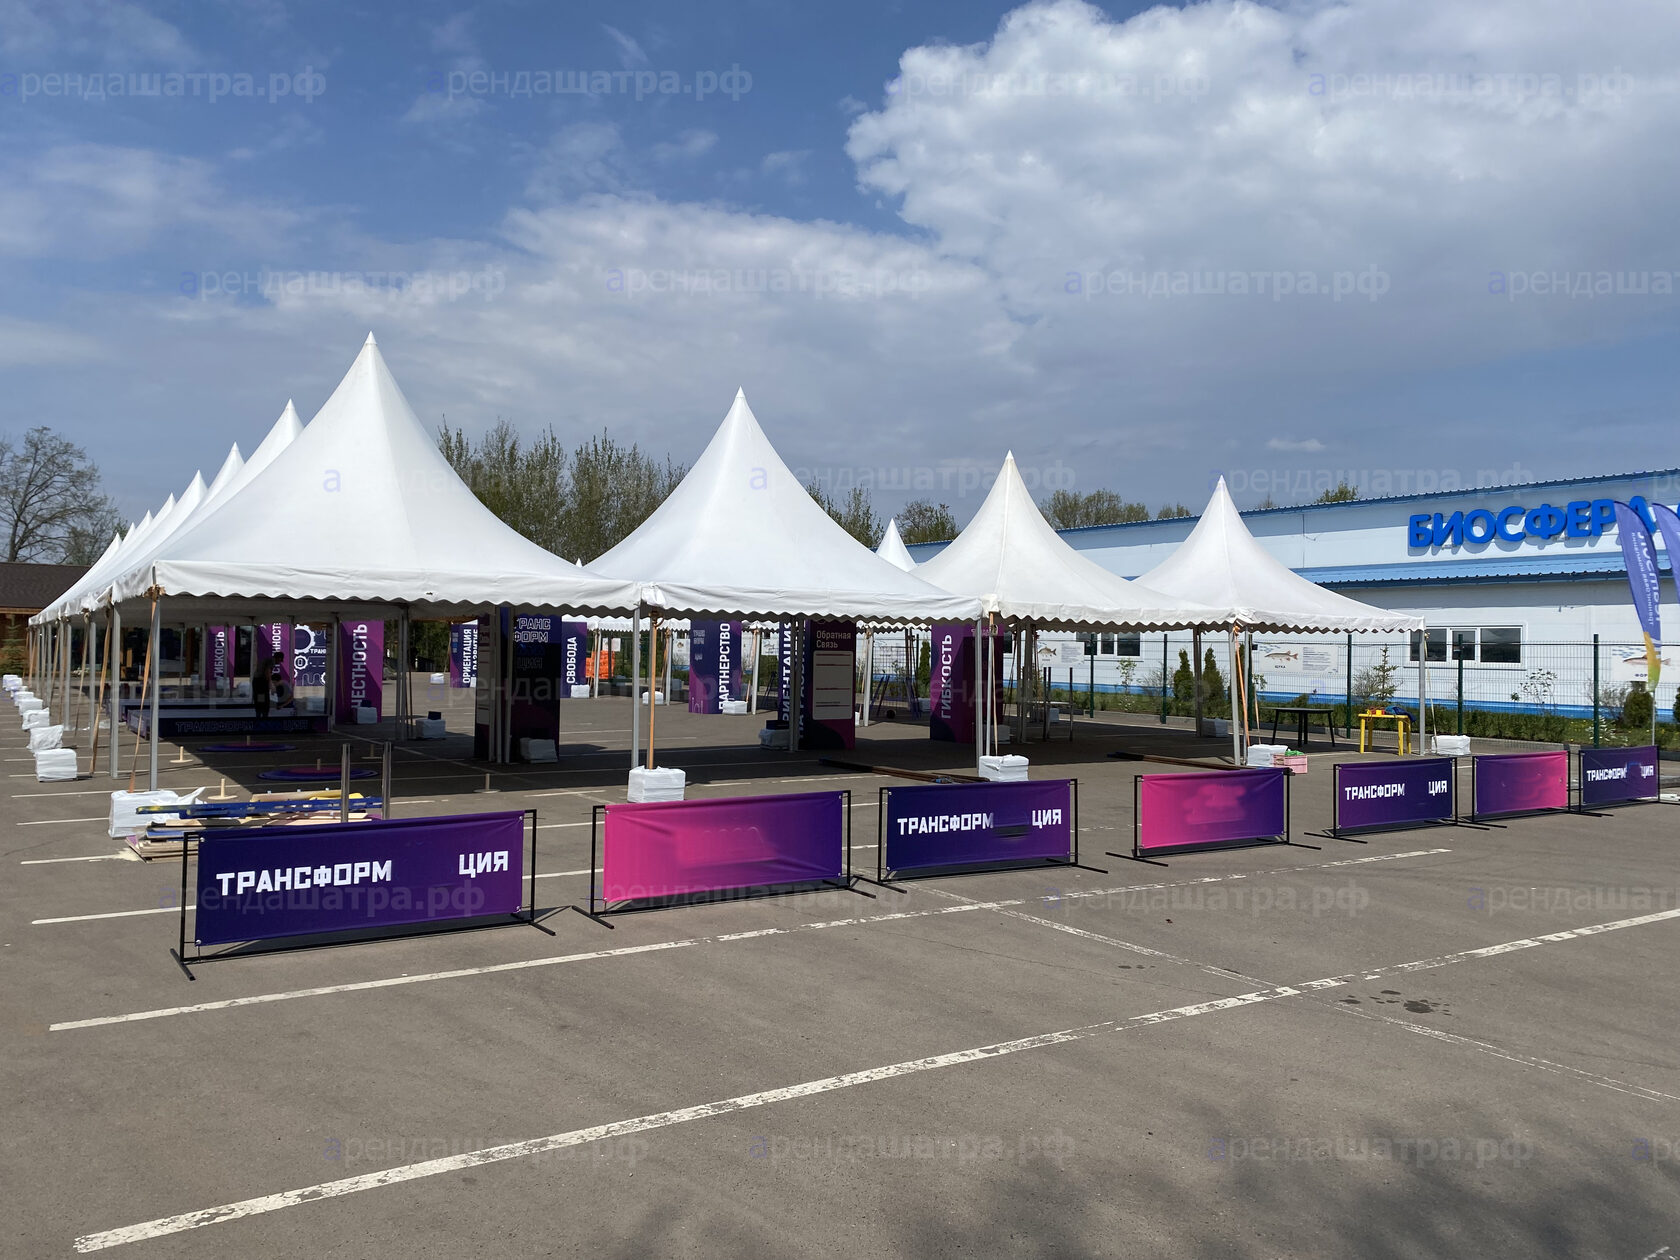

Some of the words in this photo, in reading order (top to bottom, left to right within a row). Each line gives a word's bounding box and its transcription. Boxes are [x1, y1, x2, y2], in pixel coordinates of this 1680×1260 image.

[816, 630, 852, 641] Обратная
[816, 639, 839, 649] Связь
[462, 628, 472, 684] ОРИЕНТАЦИЯ
[566, 636, 578, 684] СВОБОДА
[941, 634, 953, 719] ГИБКОСТЬ
[1587, 767, 1627, 781] ТРАНСФОРМ
[1641, 765, 1655, 778] ЦИЯ
[1344, 783, 1405, 801] ТРАНСФОРМ
[1428, 780, 1448, 796] ЦИЯ
[897, 812, 994, 836] ТРАНСФОРМ
[1032, 808, 1062, 829] ЦИЯ
[216, 859, 392, 896] ТРАНСФОРМ
[458, 850, 509, 879] ЦИЯ
